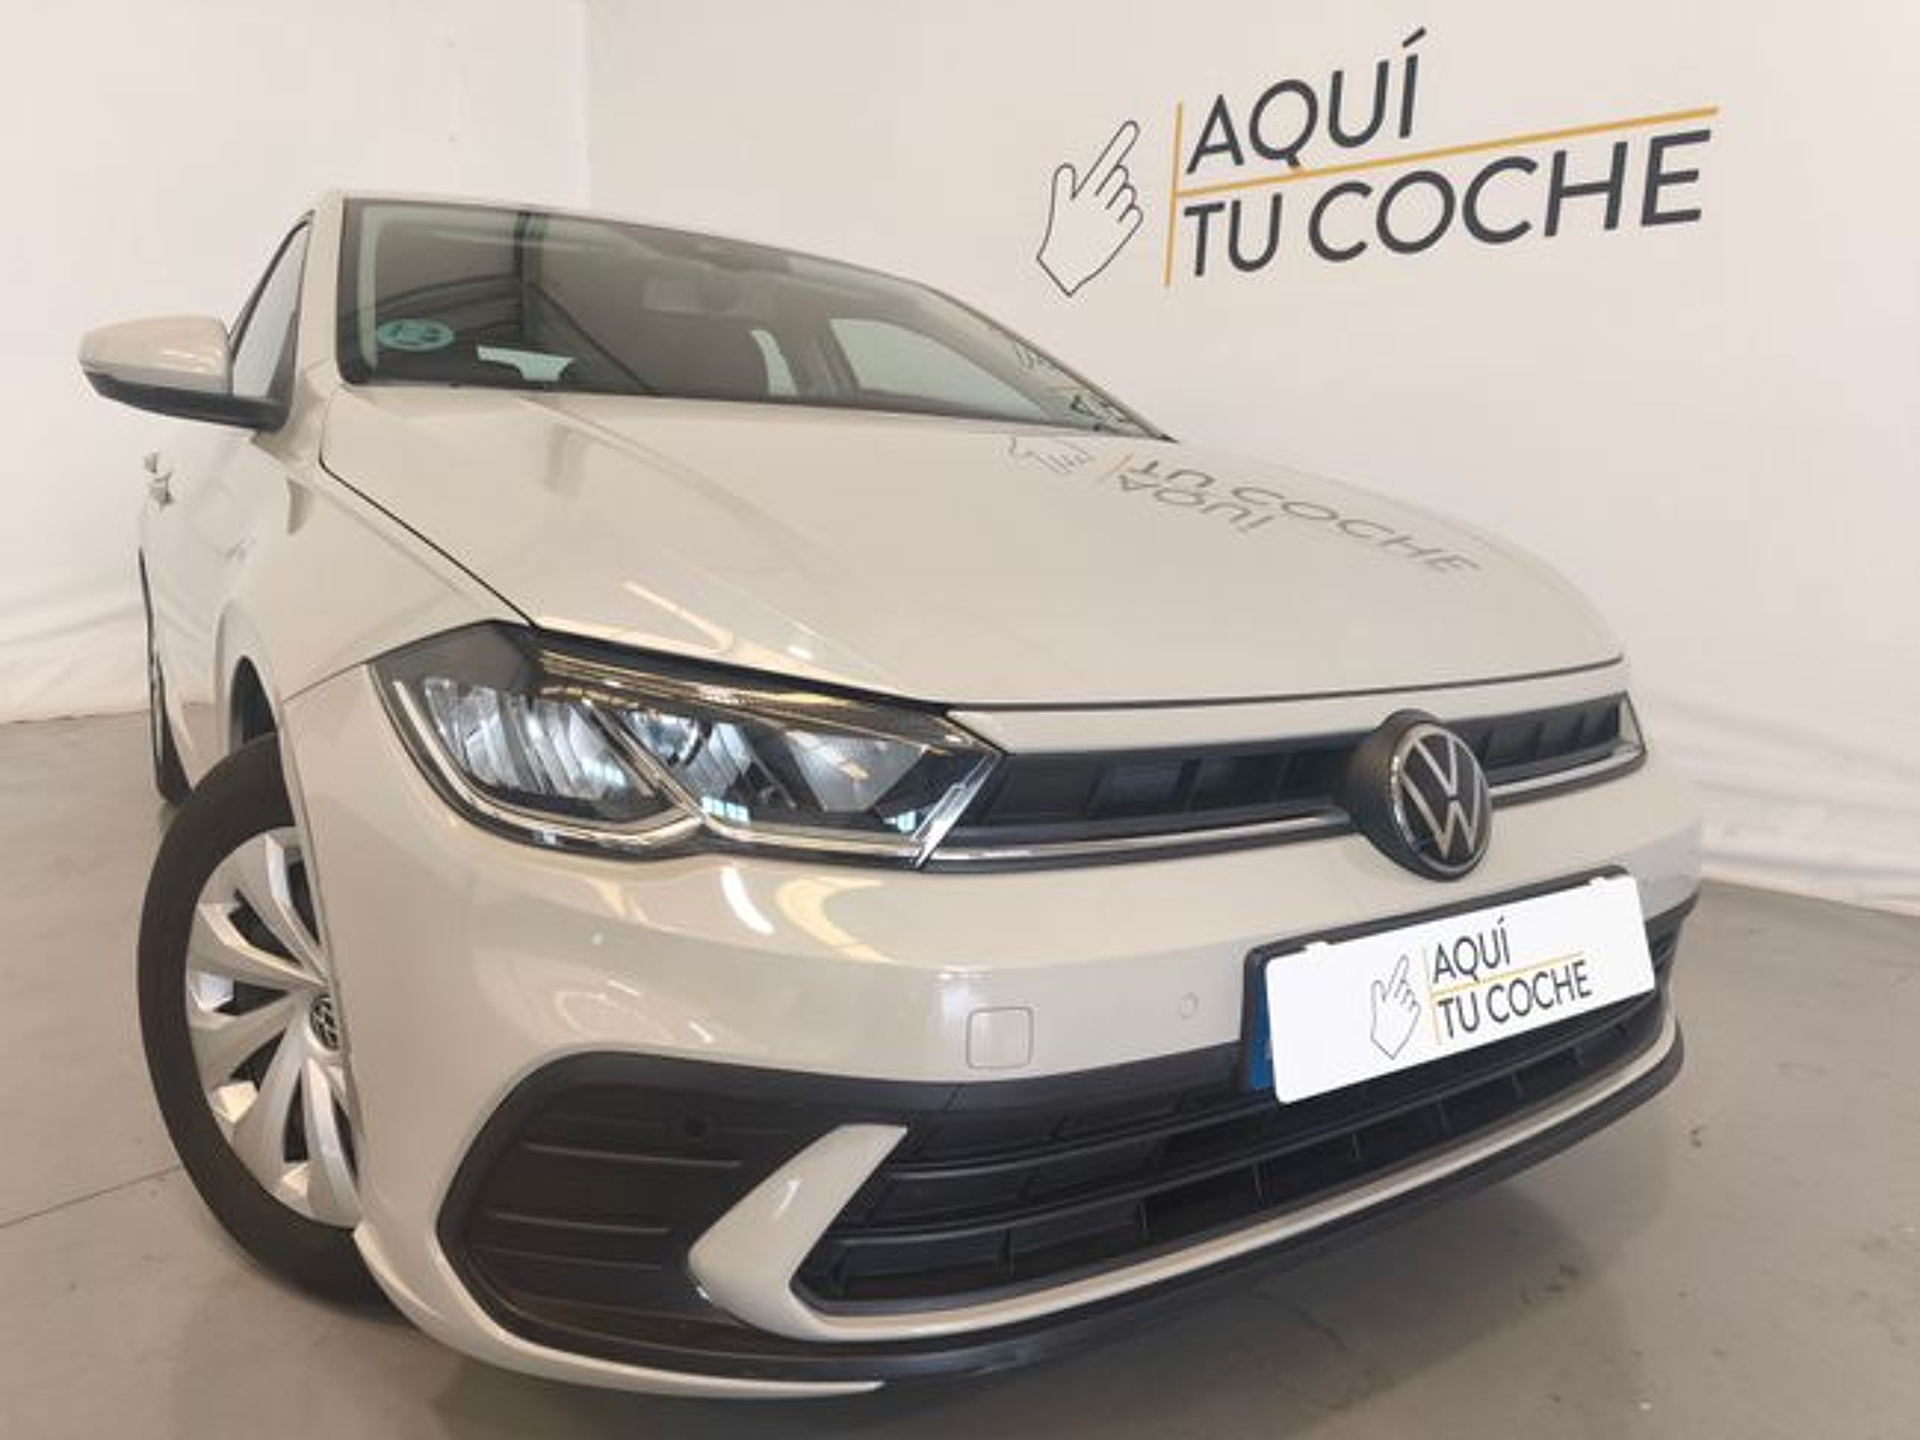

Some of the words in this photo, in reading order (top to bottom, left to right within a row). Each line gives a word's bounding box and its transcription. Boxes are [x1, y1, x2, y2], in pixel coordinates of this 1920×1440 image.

[1187, 27, 1427, 173] AQUÍ
[1183, 193, 1282, 277] TU
[1308, 129, 1711, 262] COCHE
[1432, 916, 1511, 983] AQUÍ
[1437, 995, 1480, 1038] TU
[1486, 960, 1591, 1022] COCHE
